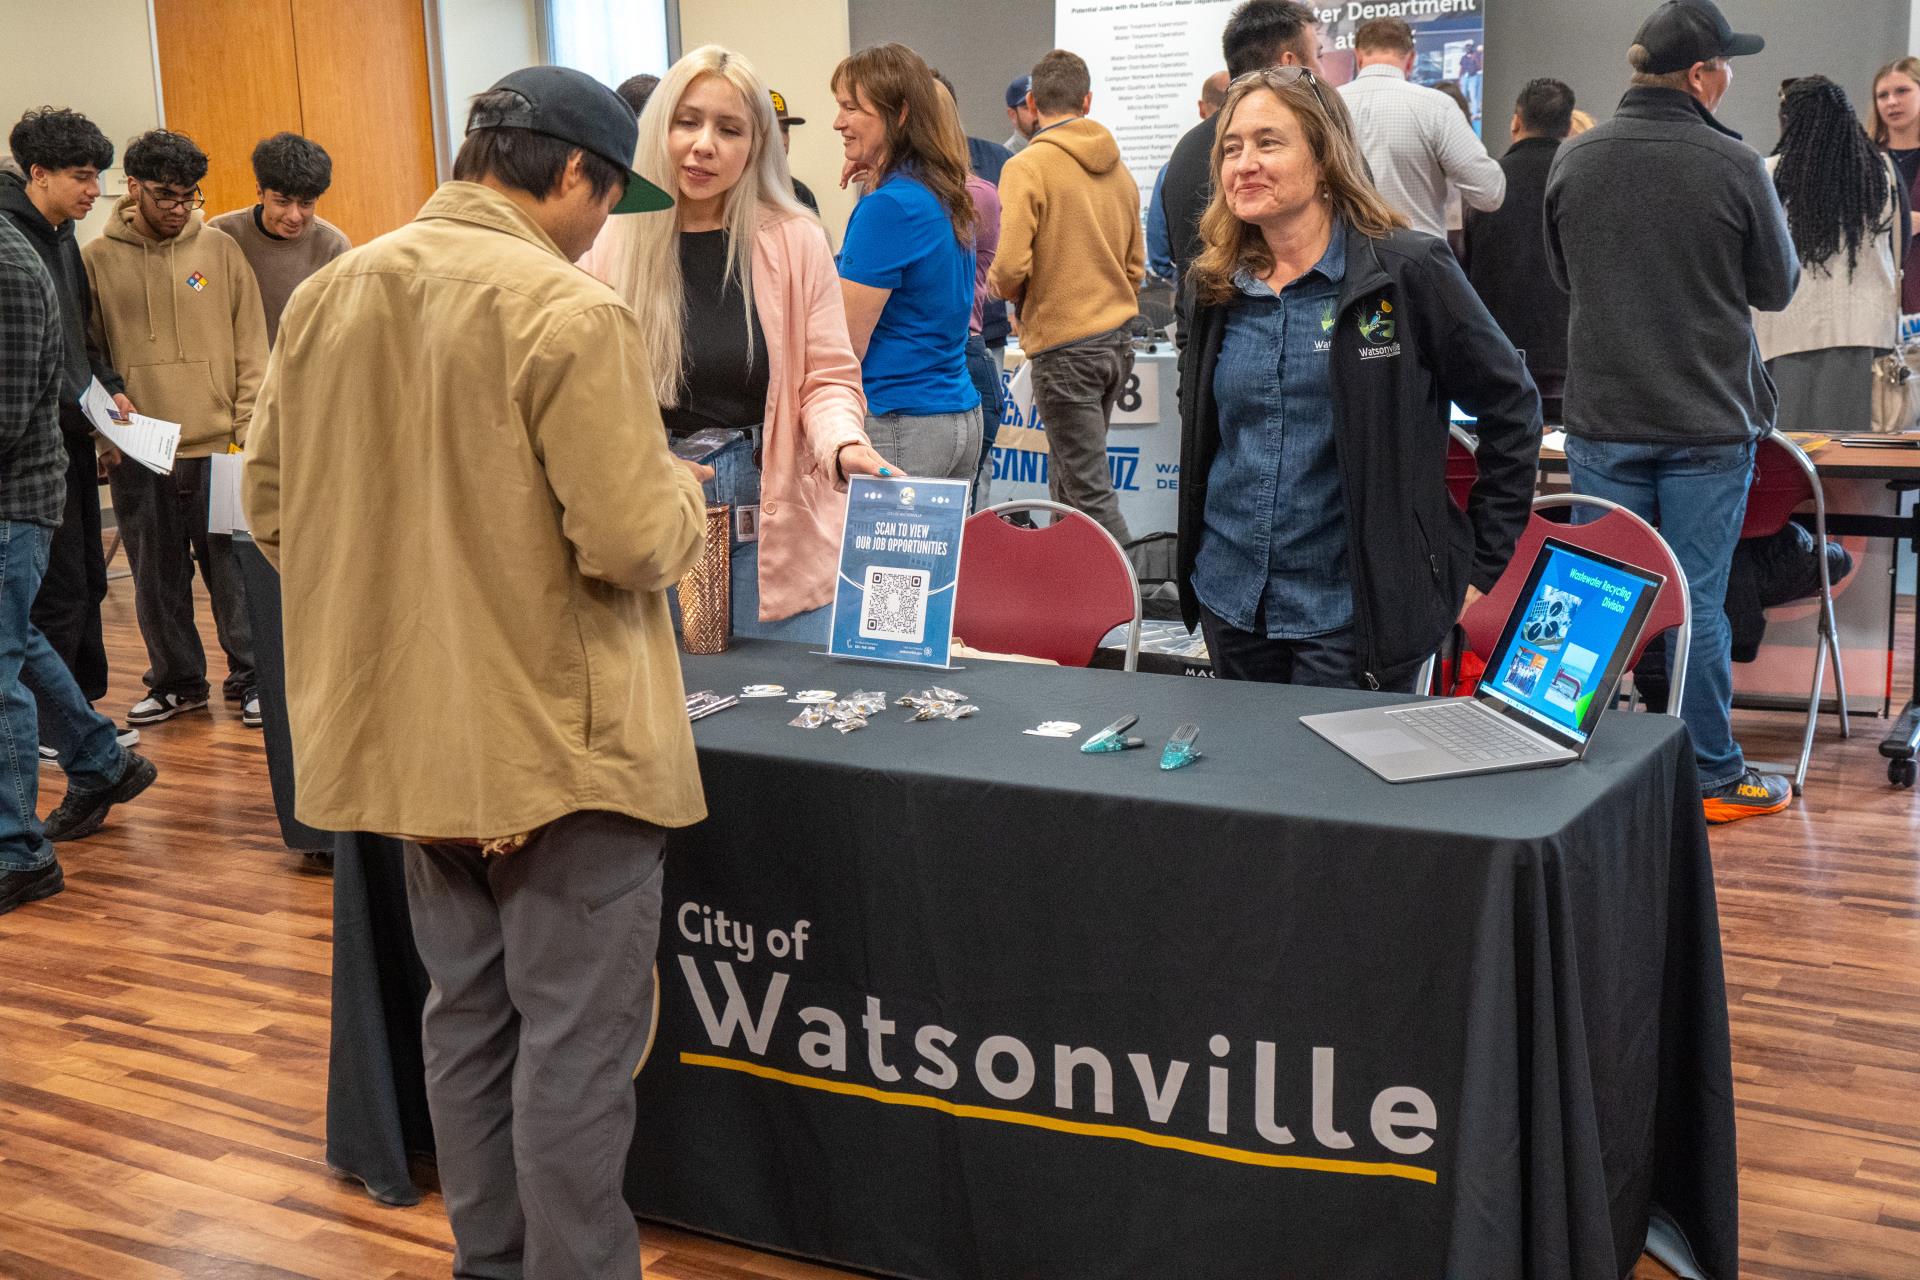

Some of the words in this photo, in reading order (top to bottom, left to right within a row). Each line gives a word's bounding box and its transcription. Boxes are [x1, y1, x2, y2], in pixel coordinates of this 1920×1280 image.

[1313, 7, 1342, 23] ter
[1347, 0, 1477, 20] Department
[1117, 373, 1142, 412] 8
[990, 447, 1048, 484] SANT
[1109, 455, 1139, 491] UZ
[874, 521, 897, 536] SCAN
[898, 522, 908, 537] TO
[909, 523, 930, 539] VIEW
[855, 535, 871, 550] OUR
[872, 536, 886, 551] JOB
[887, 537, 948, 556] OPPORTUNITIES
[1569, 567, 1603, 588] Wastewater
[1602, 580, 1632, 602] Recycling
[1601, 596, 1625, 613] Division
[1736, 783, 1769, 798] HOKA
[677, 901, 755, 961] City
[765, 919, 812, 961] of
[677, 954, 1438, 1155] Watsonville
